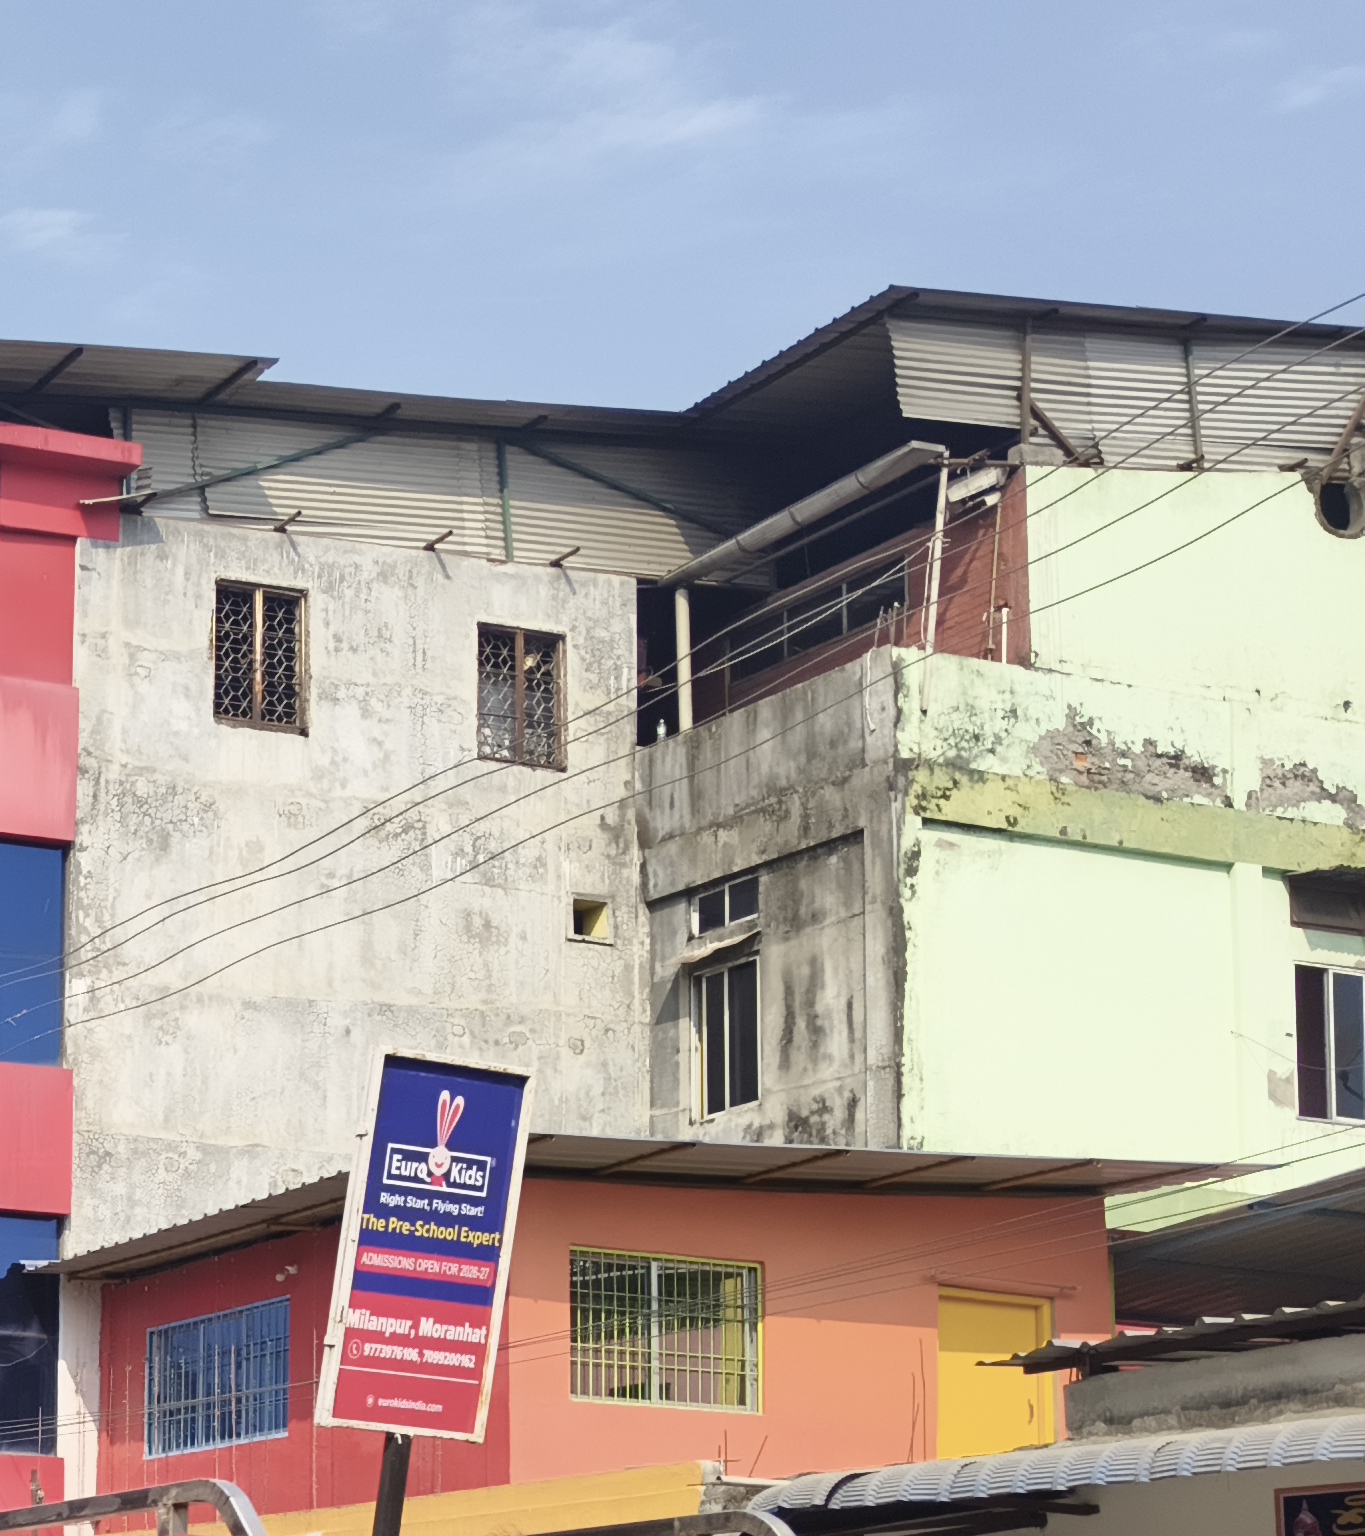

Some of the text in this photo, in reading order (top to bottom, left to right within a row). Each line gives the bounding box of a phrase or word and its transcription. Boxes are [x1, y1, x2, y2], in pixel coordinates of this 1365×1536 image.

[391, 1154, 484, 1186] Euro Kids
[380, 1192, 485, 1216] Right Start, Flying Start!
[362, 1214, 500, 1247] The Pre-School Expert
[361, 1252, 415, 1271] ADMISSIONS
[416, 1259, 440, 1274] OPEN
[441, 1261, 459, 1276] FOR
[346, 1308, 487, 1344] Milanpur, Moranhat
